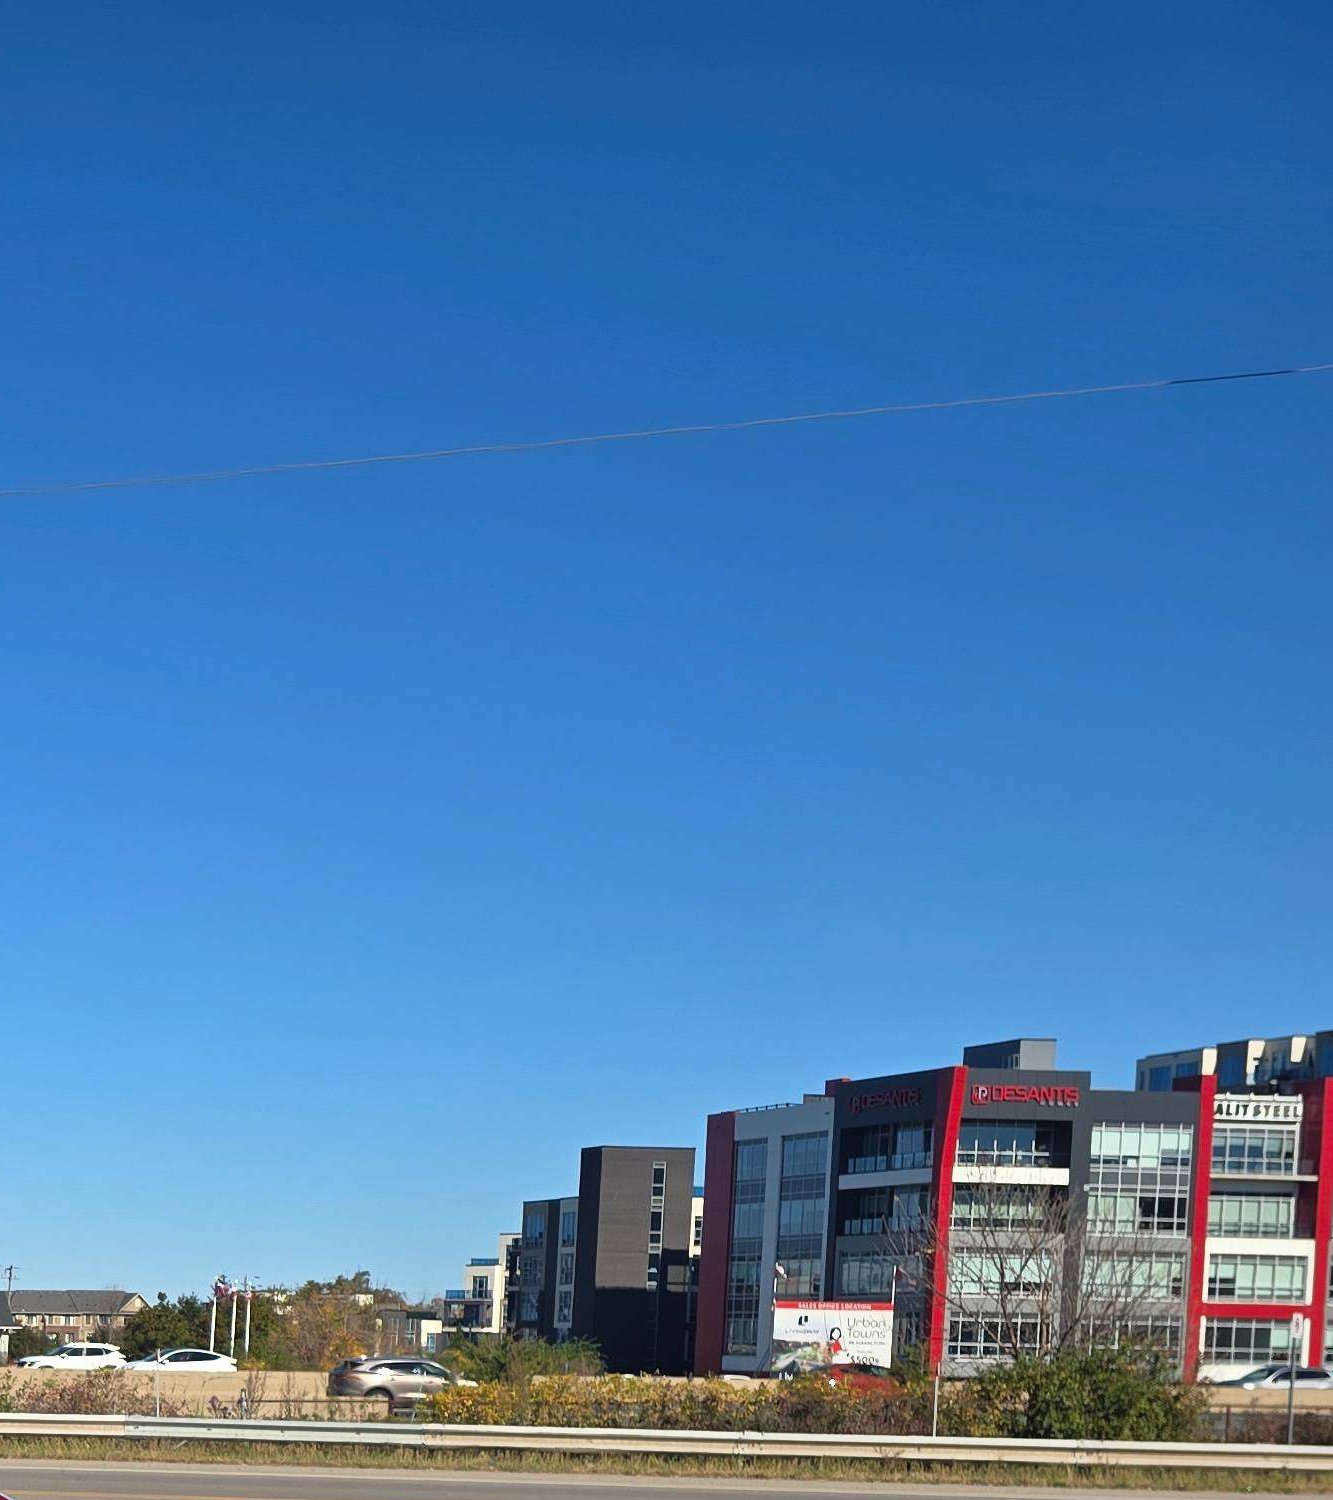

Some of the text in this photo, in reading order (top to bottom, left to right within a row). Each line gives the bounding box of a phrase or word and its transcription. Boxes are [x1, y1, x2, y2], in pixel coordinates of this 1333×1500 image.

[992, 1085, 1080, 1106] DESANTIS
[1252, 1104, 1301, 1118] STEEL
[847, 1317, 887, 1328] Urban
[847, 1328, 886, 1339] Towns
